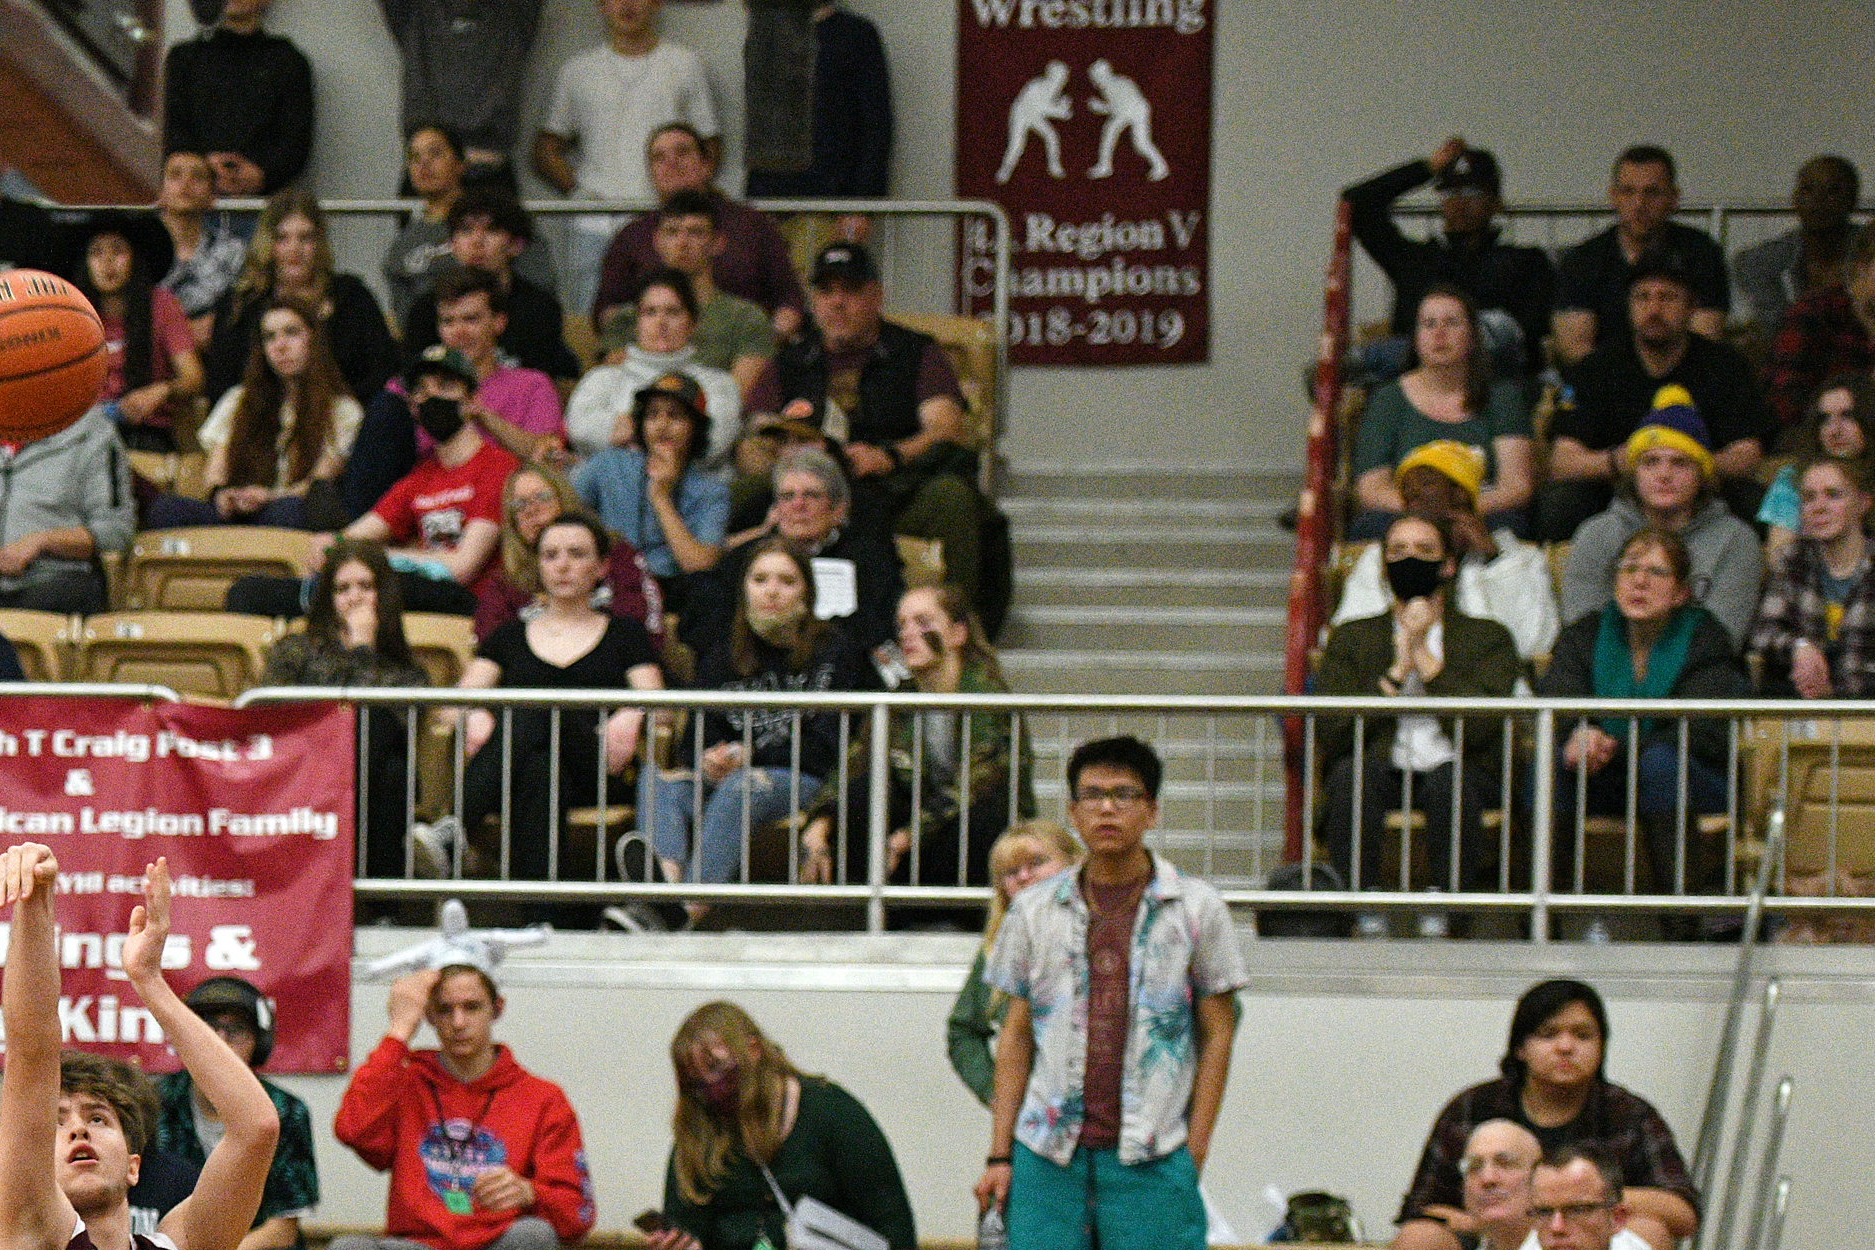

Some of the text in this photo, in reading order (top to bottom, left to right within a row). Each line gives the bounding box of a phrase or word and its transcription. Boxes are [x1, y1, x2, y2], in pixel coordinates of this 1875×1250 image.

[974, 0, 1207, 34] Wrestling
[1025, 212, 1165, 260] Region
[1169, 209, 1202, 248] V
[977, 306, 1186, 349] 018-2019
[24, 729, 47, 757] T
[52, 729, 150, 762] Craig
[63, 768, 95, 797] &
[79, 806, 205, 839] Legion
[208, 808, 339, 840] Family
[205, 924, 263, 972] &
[57, 994, 175, 1057] Kin
